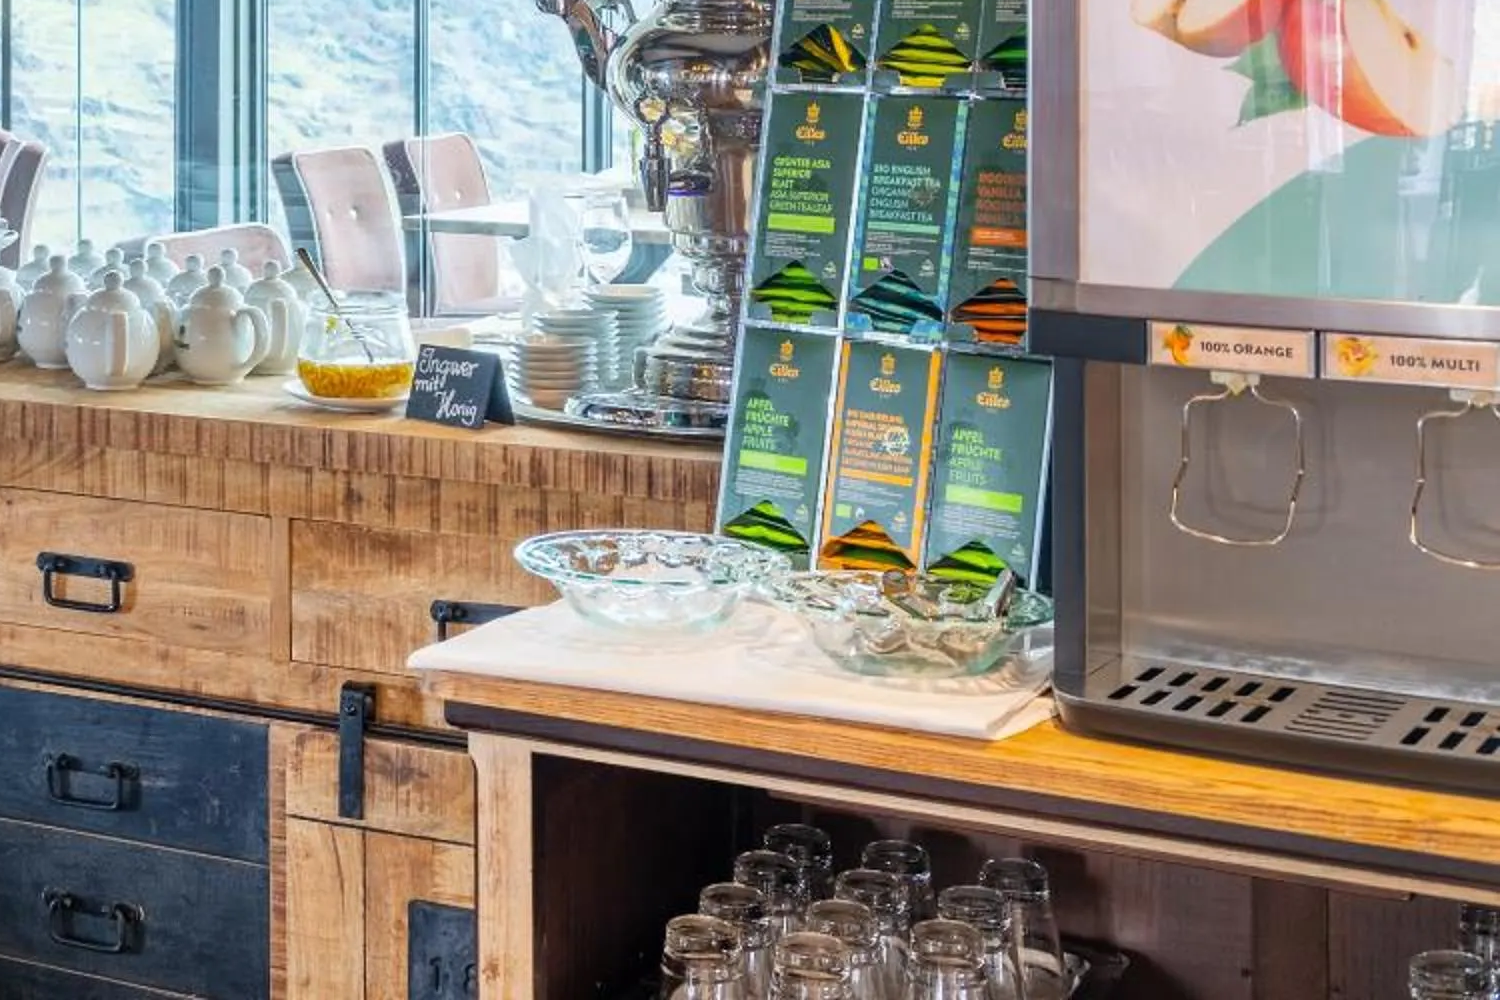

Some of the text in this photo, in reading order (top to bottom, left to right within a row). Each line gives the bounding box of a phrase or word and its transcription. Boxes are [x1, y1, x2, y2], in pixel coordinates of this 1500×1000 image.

[1200, 341, 1294, 359] 100% ORANGE
[1390, 354, 1481, 373] 100% MULTI
[414, 375, 441, 391] mit
[435, 390, 478, 427] Honig
